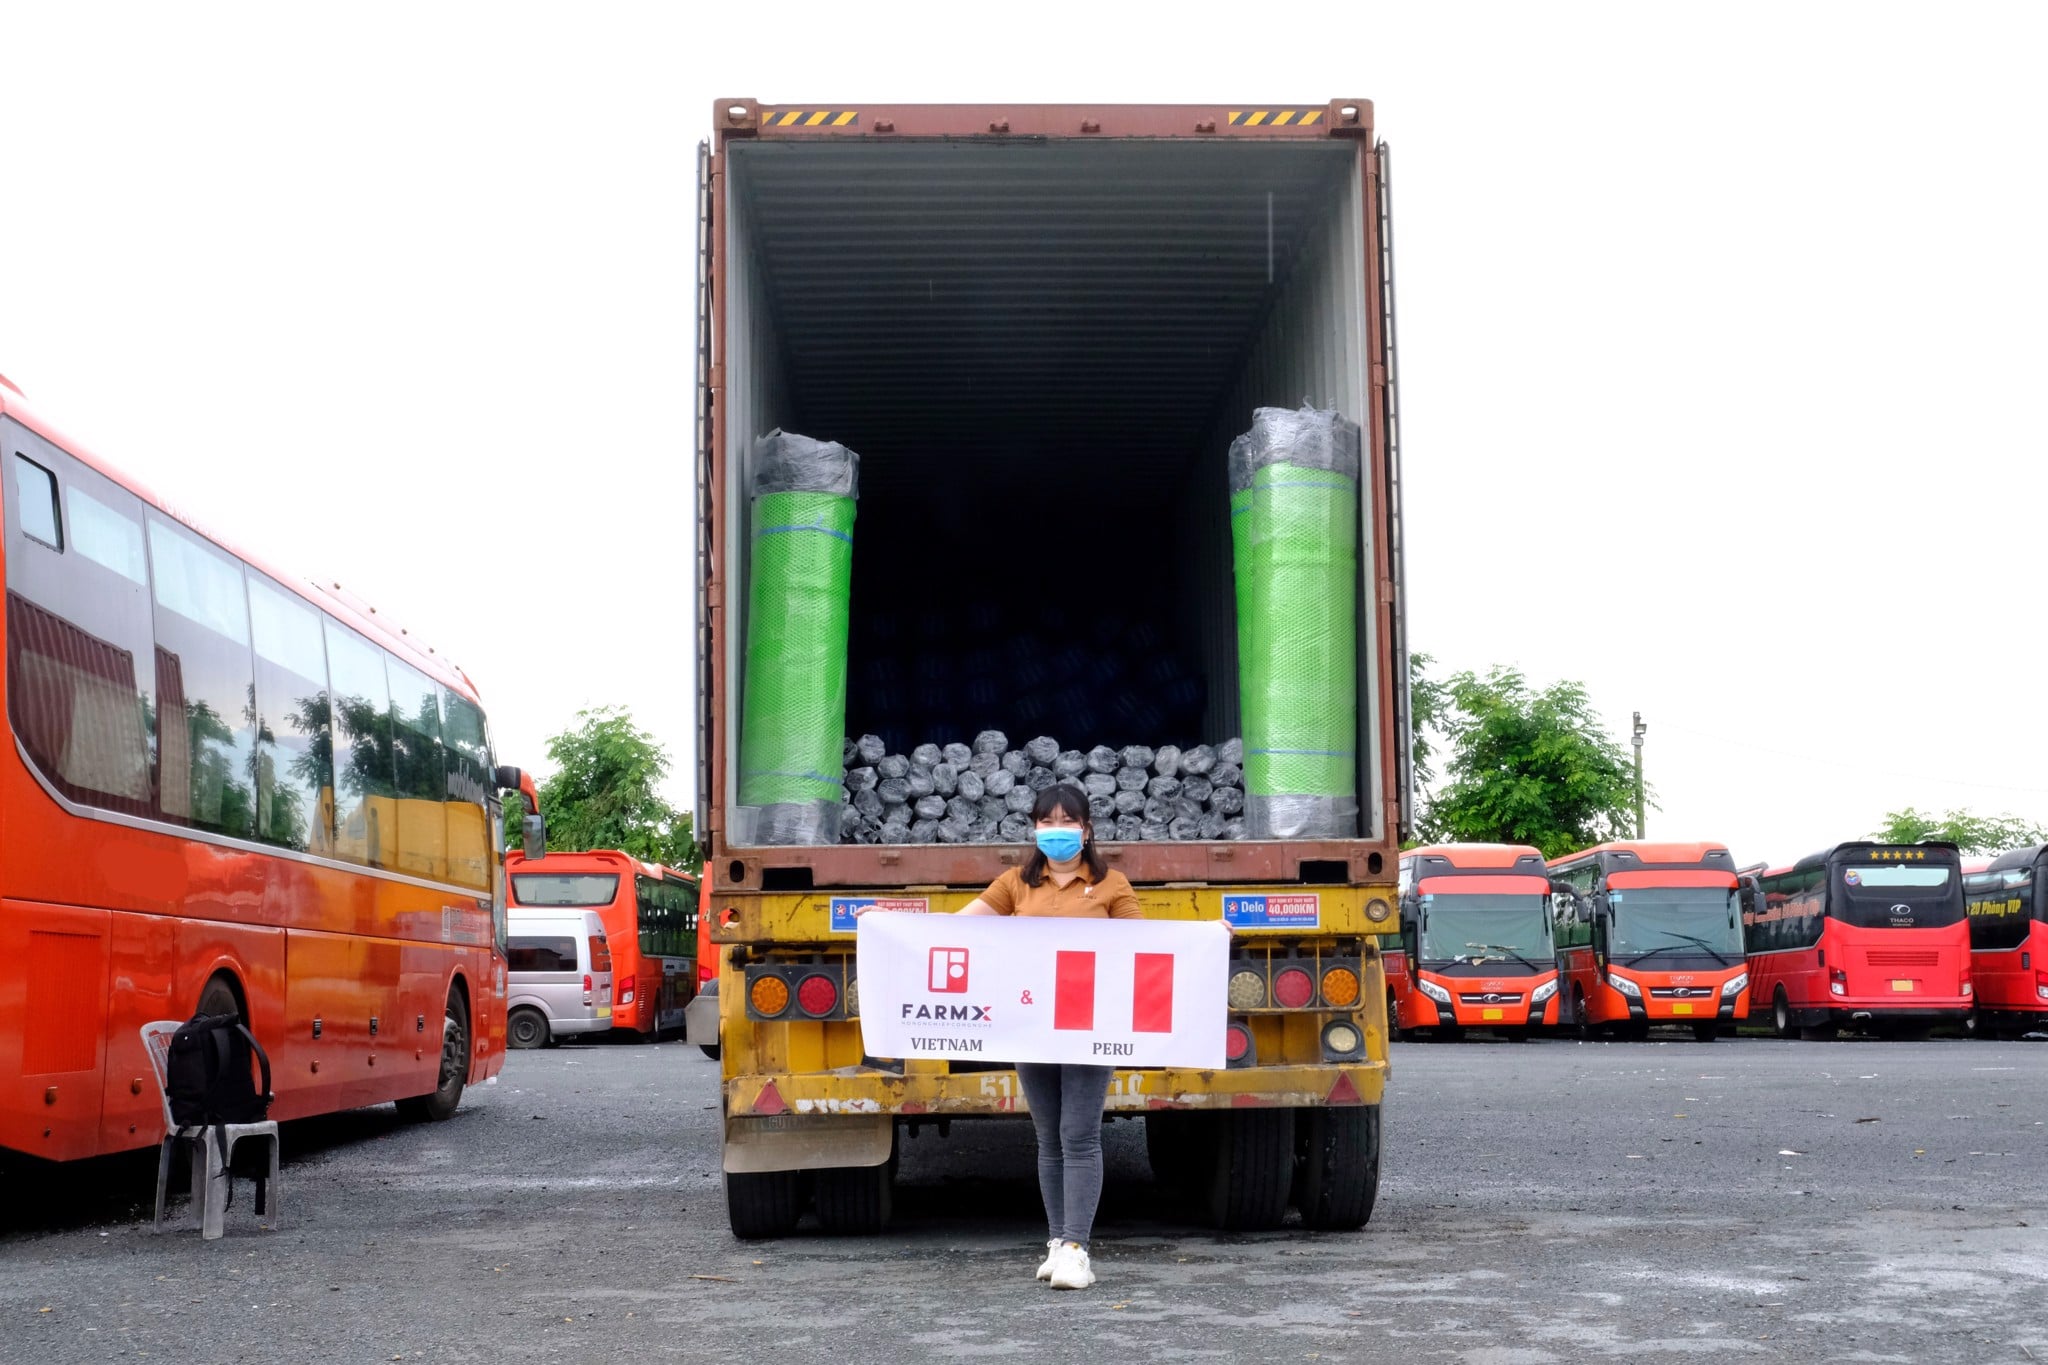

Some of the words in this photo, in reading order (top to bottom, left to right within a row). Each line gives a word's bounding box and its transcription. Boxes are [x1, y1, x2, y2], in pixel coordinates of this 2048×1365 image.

[1241, 901, 1264, 912] Delo
[1268, 903, 1315, 915] 40,000KM
[1021, 989, 1034, 1005] &
[901, 1003, 993, 1022] FARMX
[911, 1037, 983, 1052] VIETNAM
[1092, 1042, 1134, 1056] PERU
